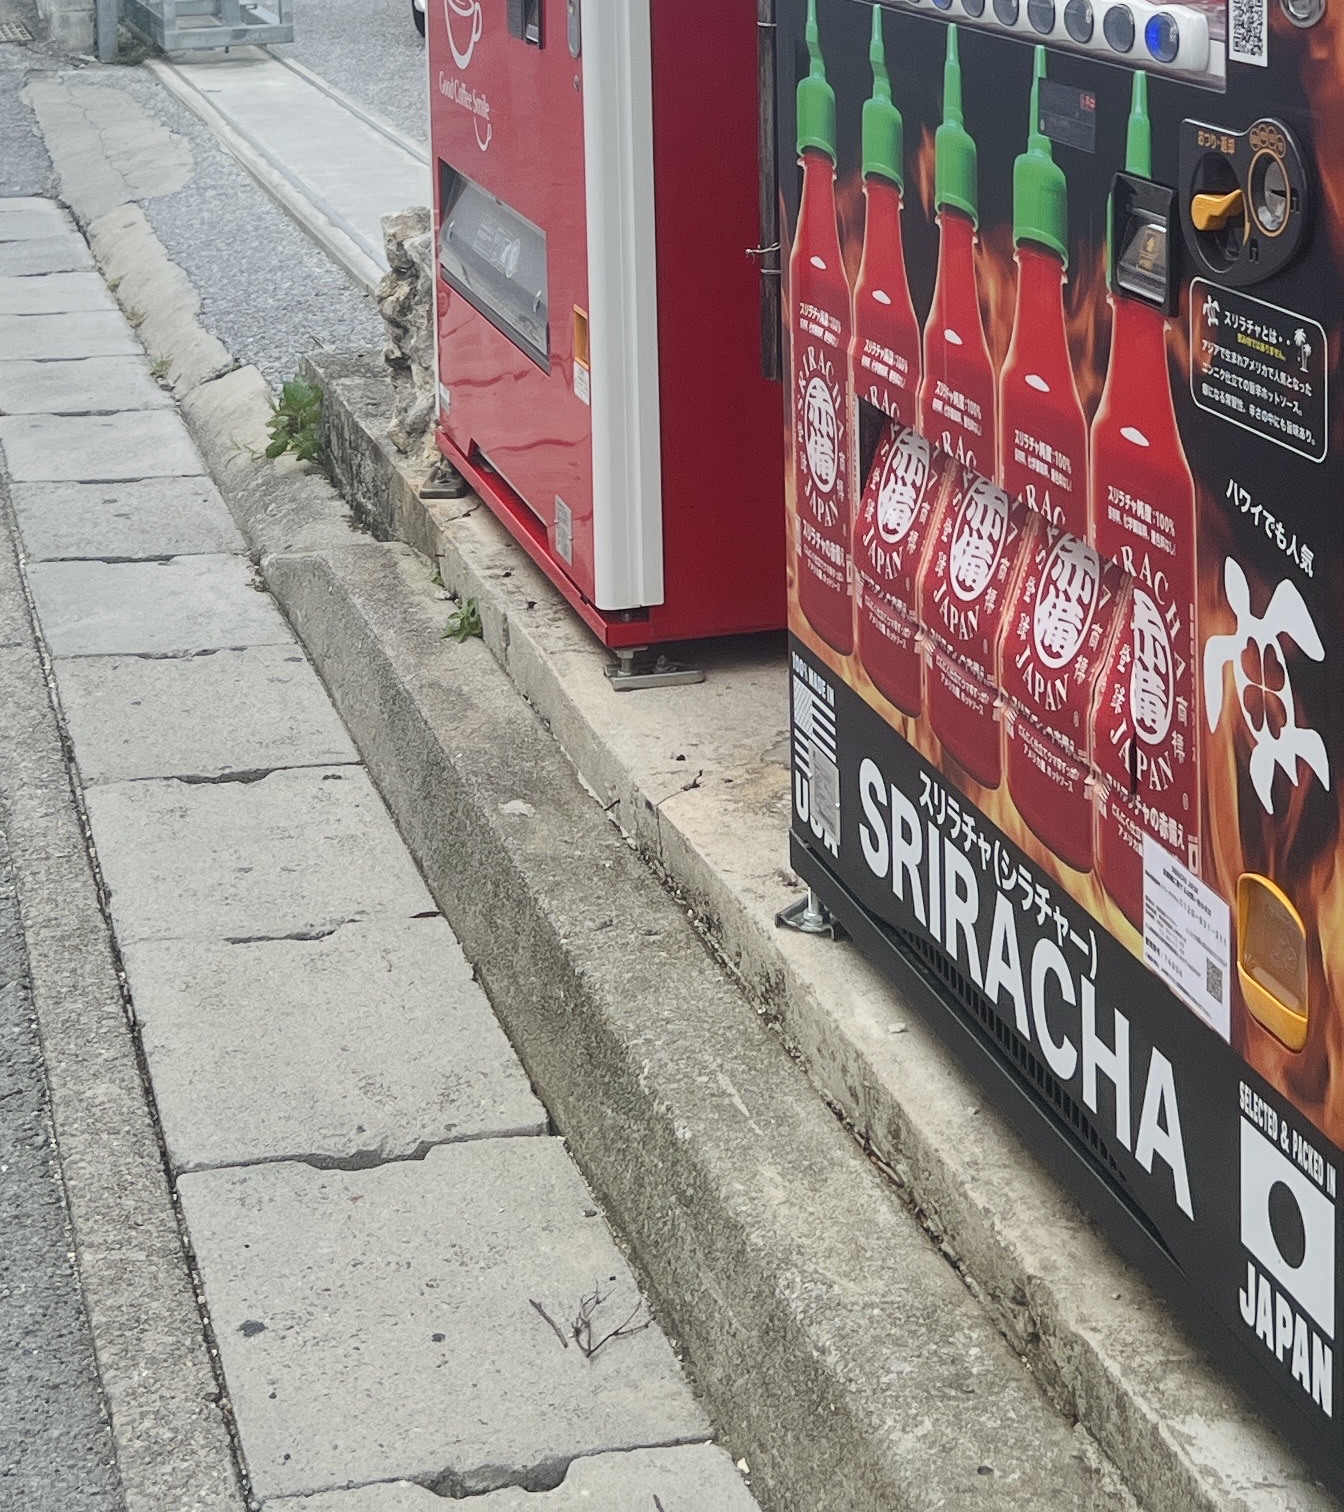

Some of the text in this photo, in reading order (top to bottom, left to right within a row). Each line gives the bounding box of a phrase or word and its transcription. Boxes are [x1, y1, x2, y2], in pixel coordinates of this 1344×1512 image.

[1226, 479, 1315, 578] ハワイでも人気
[933, 580, 979, 640] JAPAN
[1010, 644, 1069, 711] JAPAN
[1110, 718, 1174, 791] JAPAN
[859, 758, 1194, 1222] SRIRACHA
[1239, 1080, 1278, 1142] SELECTED
[1292, 1129, 1324, 1185] PACKED
[1326, 1162, 1337, 1198] IN
[1239, 1261, 1333, 1418] JAPAN
